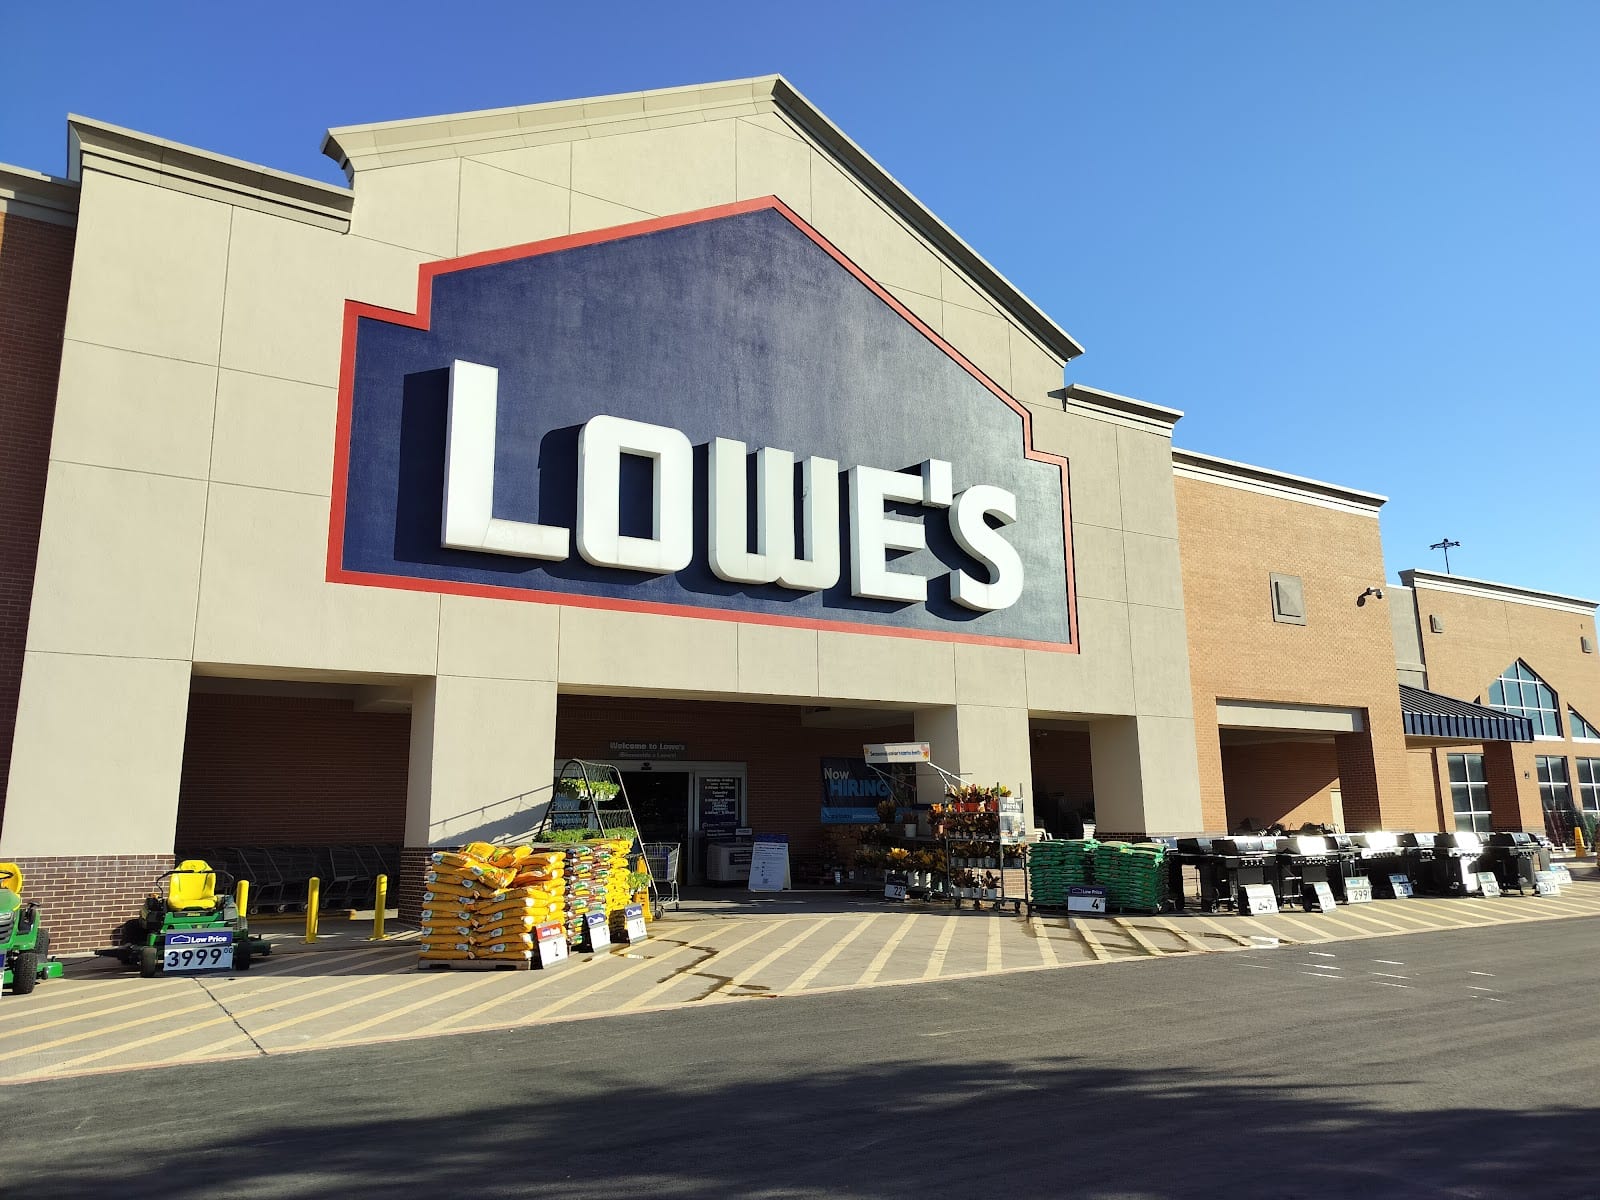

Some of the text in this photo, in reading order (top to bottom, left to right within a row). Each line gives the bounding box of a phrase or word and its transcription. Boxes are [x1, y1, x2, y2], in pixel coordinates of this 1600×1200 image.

[441, 359, 1024, 611] LOWE'S
[824, 767, 850, 780] Now
[830, 779, 890, 797] HIRING
[1091, 898, 1099, 910] 4
[207, 935, 228, 943] Price
[167, 948, 222, 967] 3999
